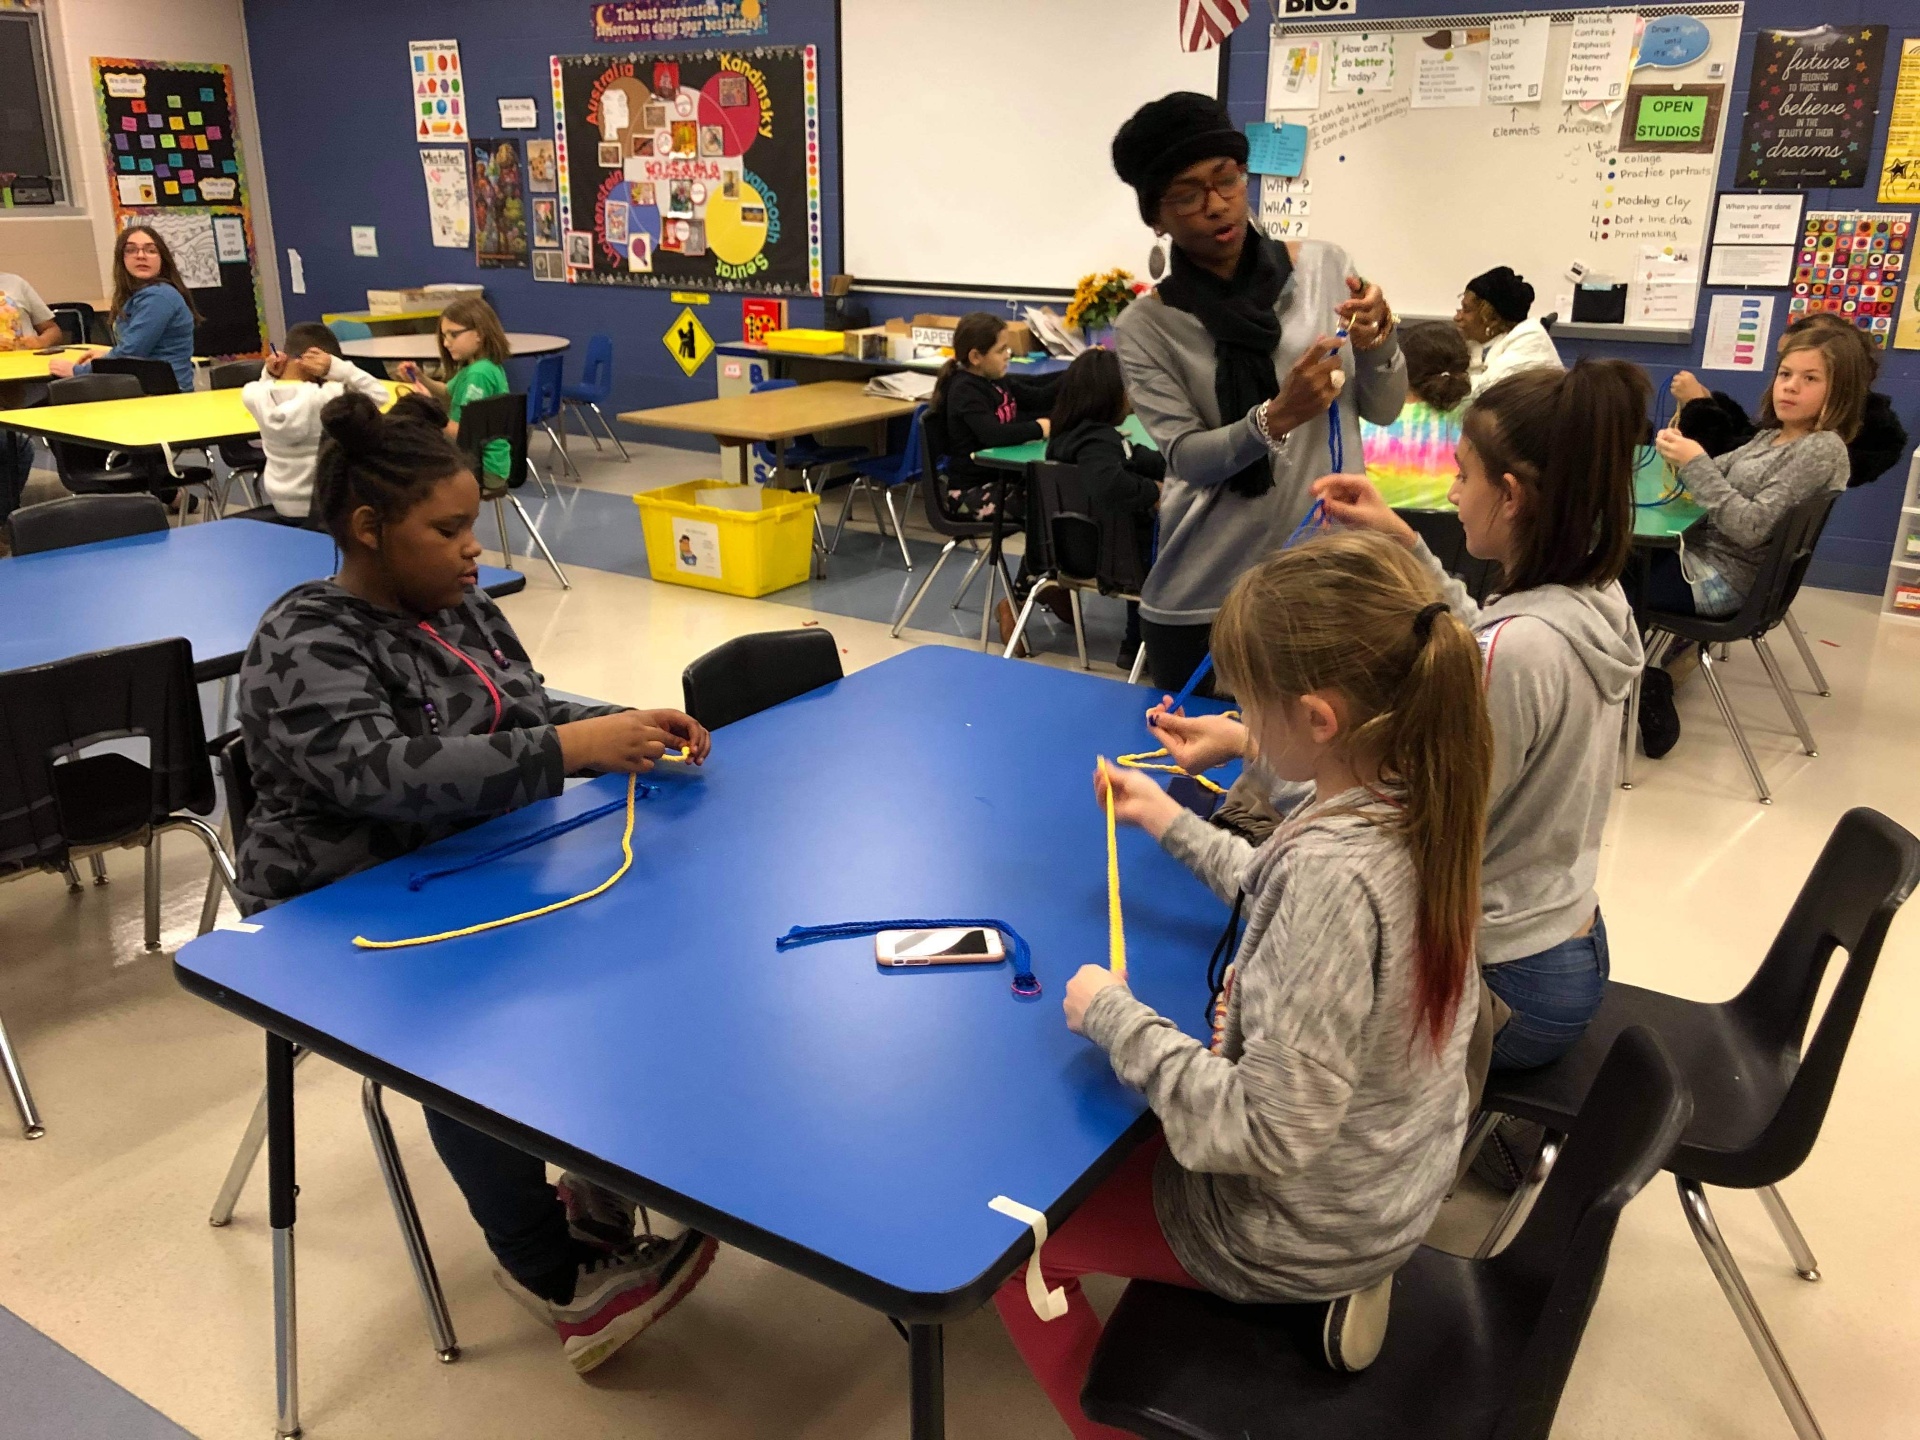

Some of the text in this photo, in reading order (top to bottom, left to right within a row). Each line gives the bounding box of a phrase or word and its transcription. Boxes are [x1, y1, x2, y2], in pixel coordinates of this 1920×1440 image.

[1341, 44, 1361, 53] How
[1363, 45, 1379, 53] can
[1814, 43, 1826, 52] THE
[1341, 58, 1385, 68] do better
[1781, 47, 1851, 81] future
[1347, 71, 1377, 84] today?
[1801, 72, 1830, 82] BELONGS
[1788, 82, 1839, 92] TO THOSE WHO
[586, 64, 634, 127] Australia
[720, 53, 773, 139] Kandinsky
[1653, 100, 1694, 113] OPEN
[1778, 93, 1847, 117] believe
[1796, 118, 1819, 127] IN THE
[1492, 122, 1541, 138] Elements
[1637, 125, 1700, 137] STUDIOS
[1777, 128, 1834, 138] BEAUTY OF THEIR
[1765, 137, 1844, 158] dreams
[1620, 167, 1665, 179] Practice
[1669, 165, 1712, 179] portraits
[1265, 179, 1292, 193] WHY
[1264, 201, 1292, 215] WHAT
[1665, 195, 1692, 212] Clay
[1615, 214, 1634, 225] Dot
[1810, 213, 1835, 221] FOCUS
[1836, 213, 1848, 221] ON
[715, 253, 769, 280] Seurat
